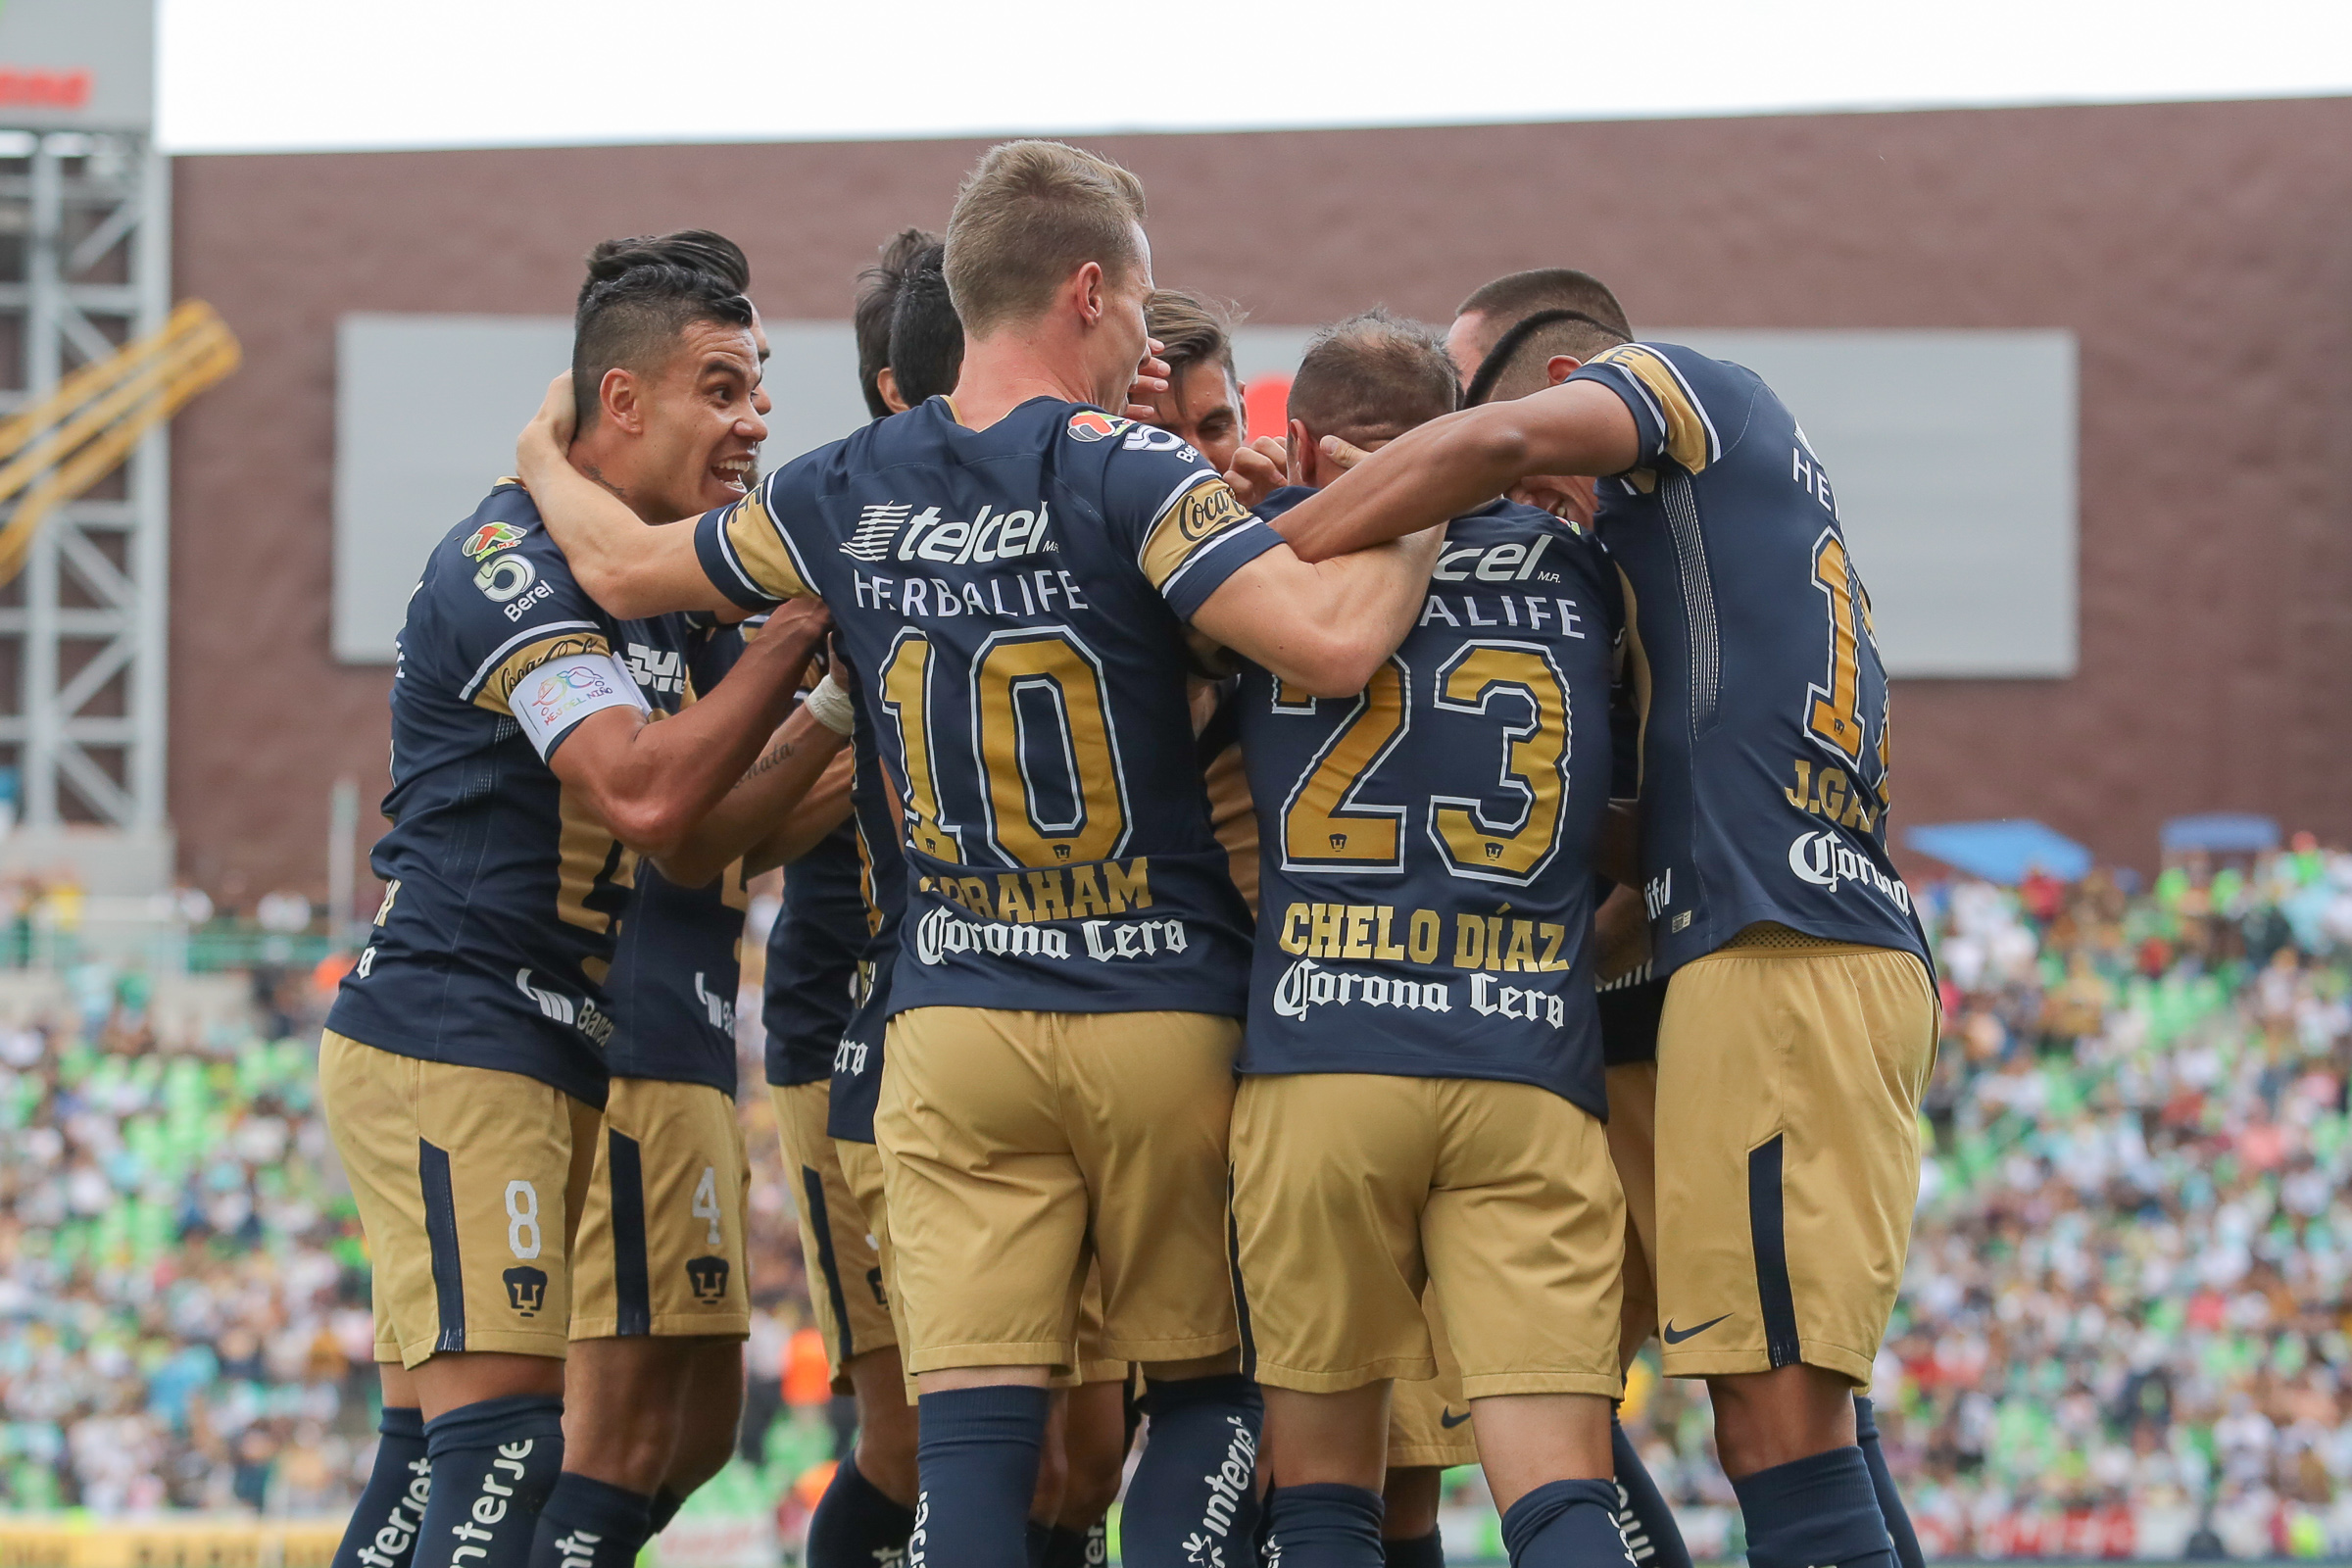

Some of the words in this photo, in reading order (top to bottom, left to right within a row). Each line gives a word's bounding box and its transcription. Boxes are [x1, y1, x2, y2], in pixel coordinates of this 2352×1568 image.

[897, 500, 1050, 565] telcel
[503, 579, 555, 623] Berel
[854, 568, 1089, 617] HERBALIFE
[1537, 570, 1561, 584] M.R.
[1419, 595, 1586, 639] ALIFE
[879, 625, 1137, 871] 10
[1272, 639, 1572, 887] 23
[916, 905, 1071, 965] Corona
[1081, 918, 1189, 963] Cero
[1279, 902, 1442, 964] CHELO
[1453, 902, 1570, 973] DÍAZ
[1272, 956, 1453, 1022] Corona
[1470, 972, 1566, 1030] Cero
[834, 1039, 868, 1077] ero
[504, 1180, 542, 1259] 8
[692, 1166, 720, 1245] 4
